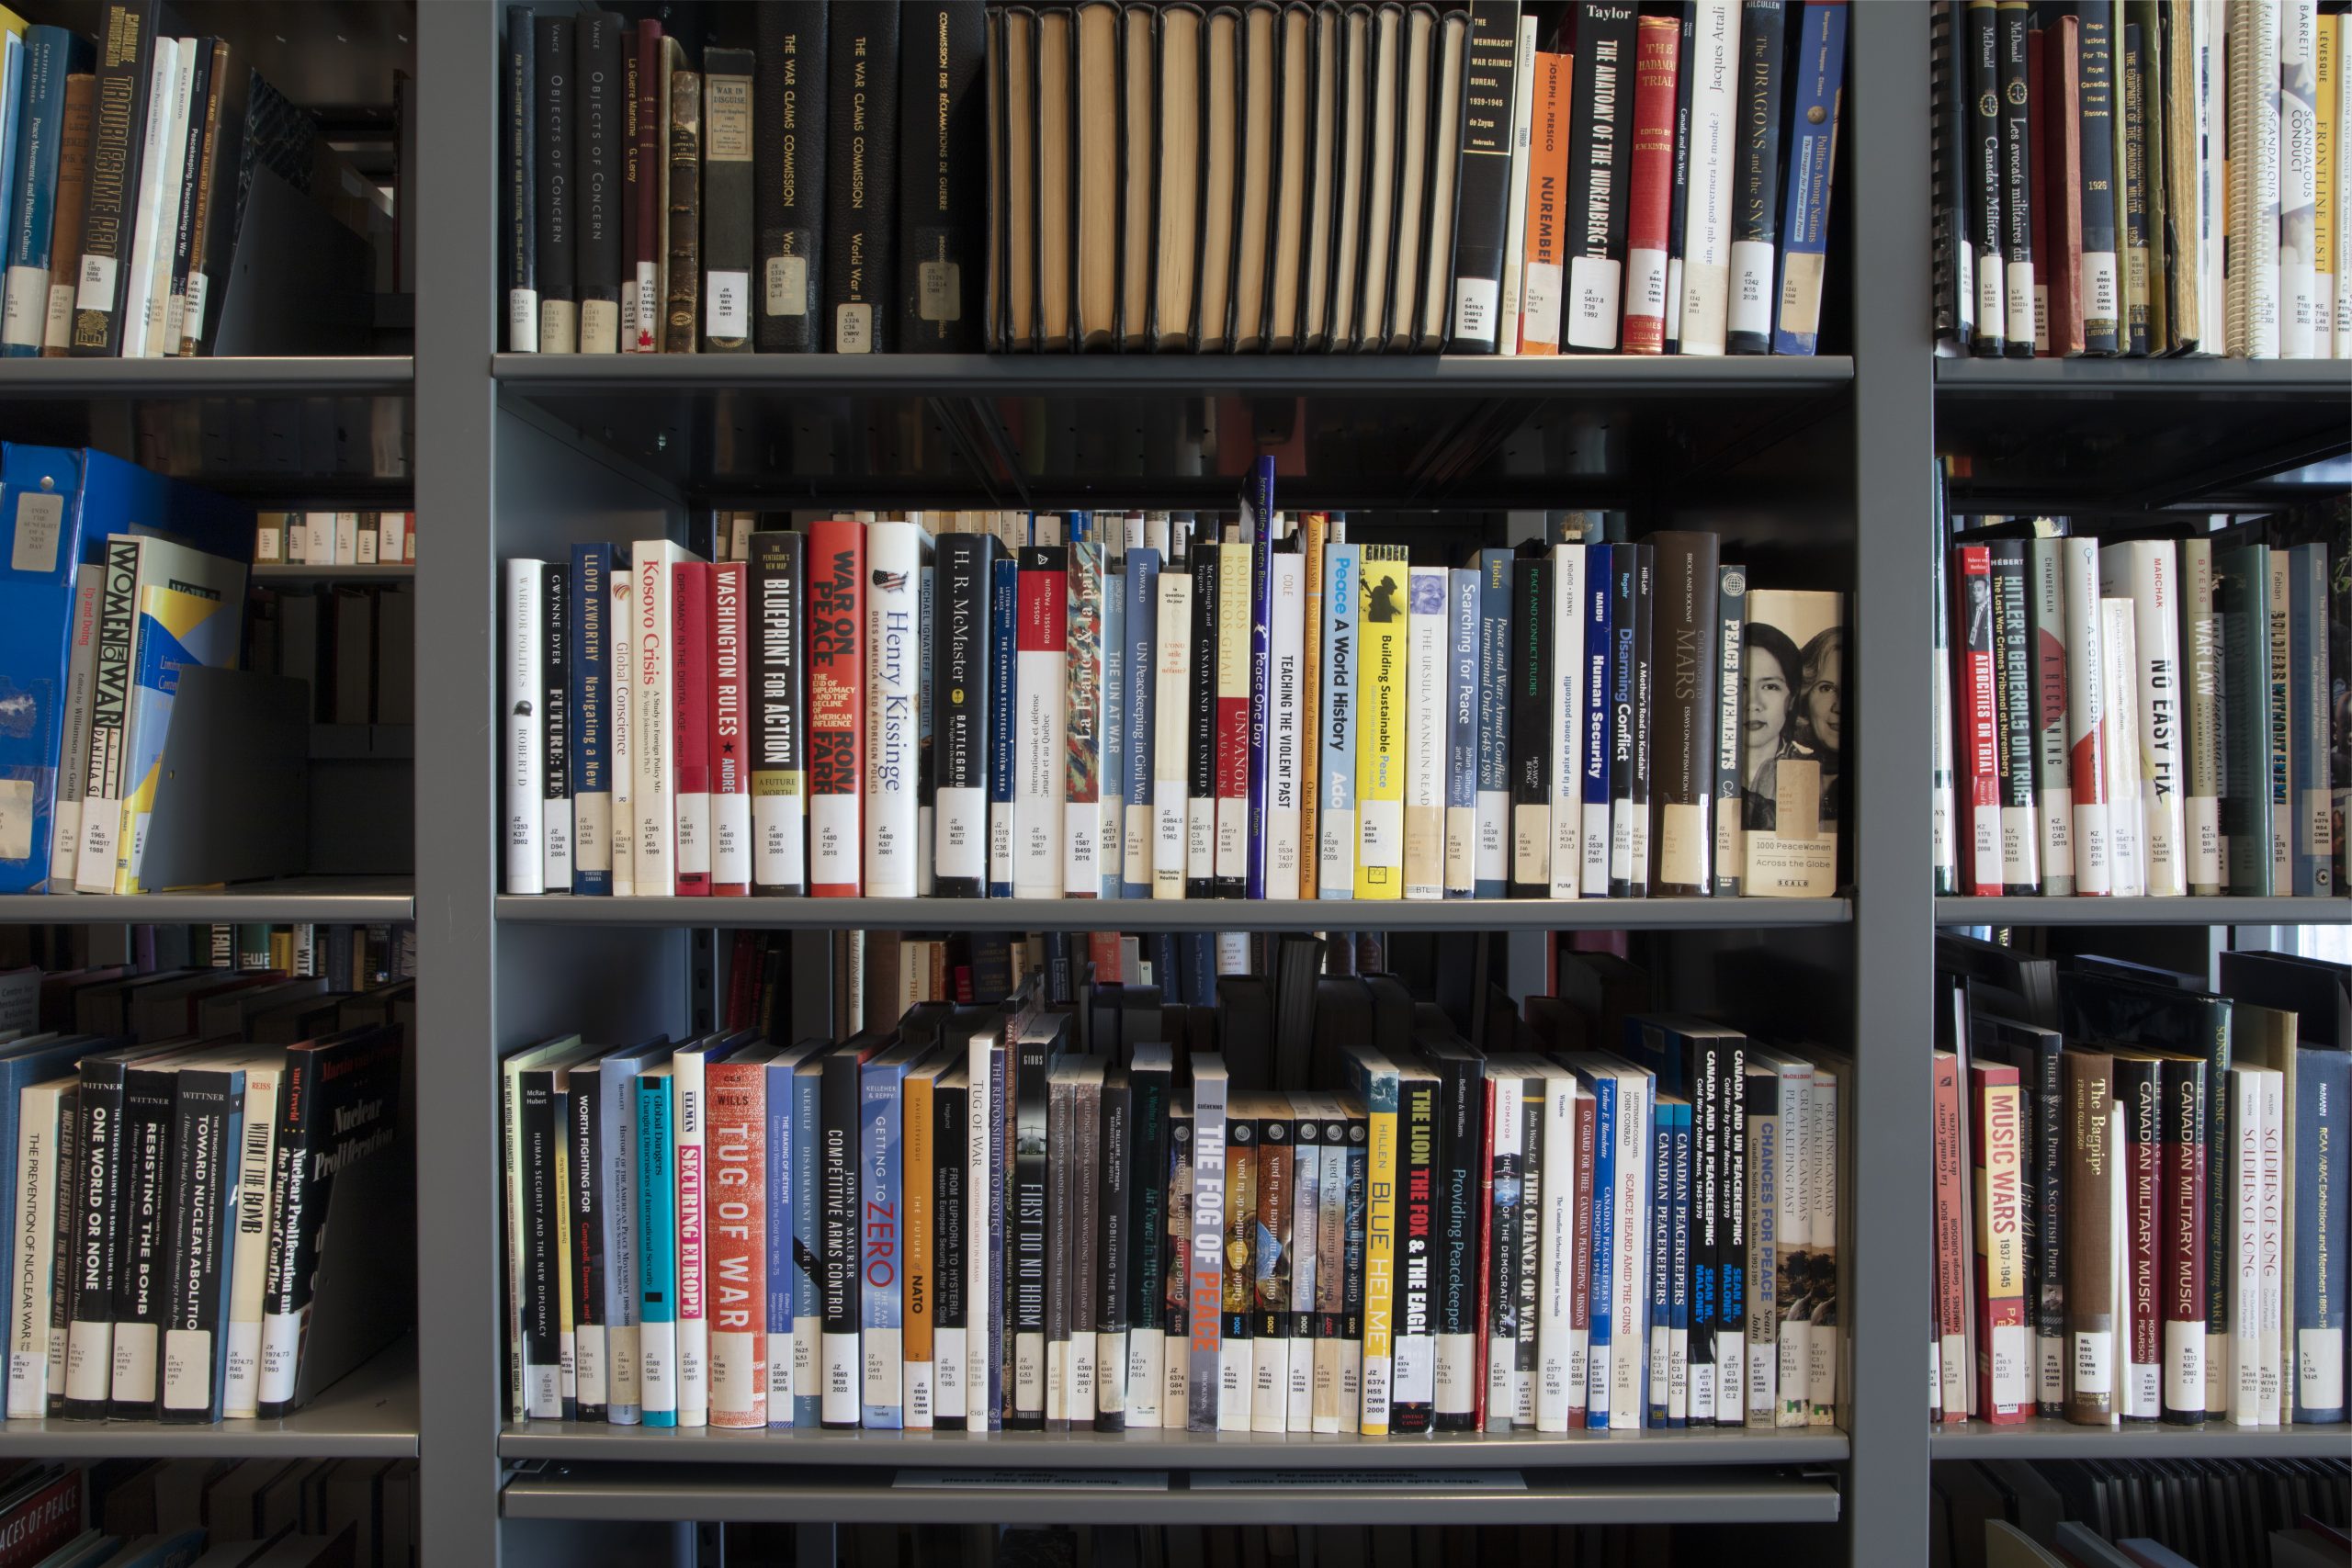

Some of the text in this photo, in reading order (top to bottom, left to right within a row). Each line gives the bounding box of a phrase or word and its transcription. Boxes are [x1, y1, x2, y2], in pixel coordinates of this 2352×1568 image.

[1472, 58, 1512, 68] WAR CRIMES
[1474, 38, 1512, 47] WEHRMACHT
[1475, 18, 1486, 27] THE
[1587, 5, 1631, 20] Taylor
[2318, 30, 2328, 84] LÉVESQUE
[92, 75, 133, 213] TROUBLESOME
[784, 35, 795, 207] THE WAR CLAIMS COMMISSION
[1470, 78, 1498, 87] BUREAU,
[1470, 97, 1503, 107] 1939-1945
[180, 183, 192, 231] Peacemaking
[186, 128, 198, 181] Peacekeeping,
[550, 75, 563, 243] OBJECTS OF CONCERN
[179, 232, 187, 241] or
[94, 543, 137, 727] WOMEN ON WAR
[813, 581, 833, 667] PEACE
[832, 550, 854, 655] WAR ON
[880, 611, 909, 687] Henry
[952, 550, 969, 682] H. R. McMaster
[2154, 558, 2163, 608] MARCHAK
[717, 571, 737, 736] WASHINGTON RULES
[764, 580, 790, 764] BLUEPRINT FOR ACTION
[1076, 562, 1097, 741] La France & la paix
[1108, 651, 1121, 753] THE UN AT WAR
[1253, 652, 1267, 748] Peace One Day
[1330, 558, 1351, 752] Peace A World History
[1458, 584, 1476, 725] Searching for Peace
[1588, 655, 1604, 778] Human Security
[1722, 619, 1740, 771] PEACE MOVEMENTS
[1973, 655, 1993, 774] ATROCITIES ON TRIAL
[2195, 620, 2213, 695] WAR LAW
[1279, 656, 1294, 808] TEACHING THE VIOLENT PAST
[2152, 660, 2176, 804] NO EASY FIX
[1757, 859, 1786, 867] Across
[1807, 859, 1830, 867] Globe
[1777, 843, 1831, 852] PeaceWomen
[242, 1122, 268, 1234] WITHOUT THE BOMB
[1371, 1124, 1390, 1249] HILLEN BLUE
[1408, 1089, 1431, 1290] THE LION THE FOX & THE
[1705, 1051, 1716, 1246] CANADA AND UN PEACEKEEPING
[1992, 1094, 2016, 1288] MUSIC WARS 1937-1945
[2086, 1079, 2106, 1176] The Bagpipe
[85, 1108, 107, 1291] ONE WORLD OR NONE
[681, 1148, 699, 1315] SECURING EUROPE
[718, 1123, 749, 1327] TUG OF WAR
[867, 1117, 894, 1288] GETTING TO ZERO
[1020, 1184, 1043, 1326] FIRST DO NO HARM
[1193, 1125, 1225, 1353] THE FOG OF PEACE
[1520, 1170, 1540, 1343] THE CHANCE OF WAR
[1657, 1133, 1668, 1305] CANADIAN PEACEKEEPERS
[2138, 1081, 2152, 1313] CANADIAN MILITARY MUSIC
